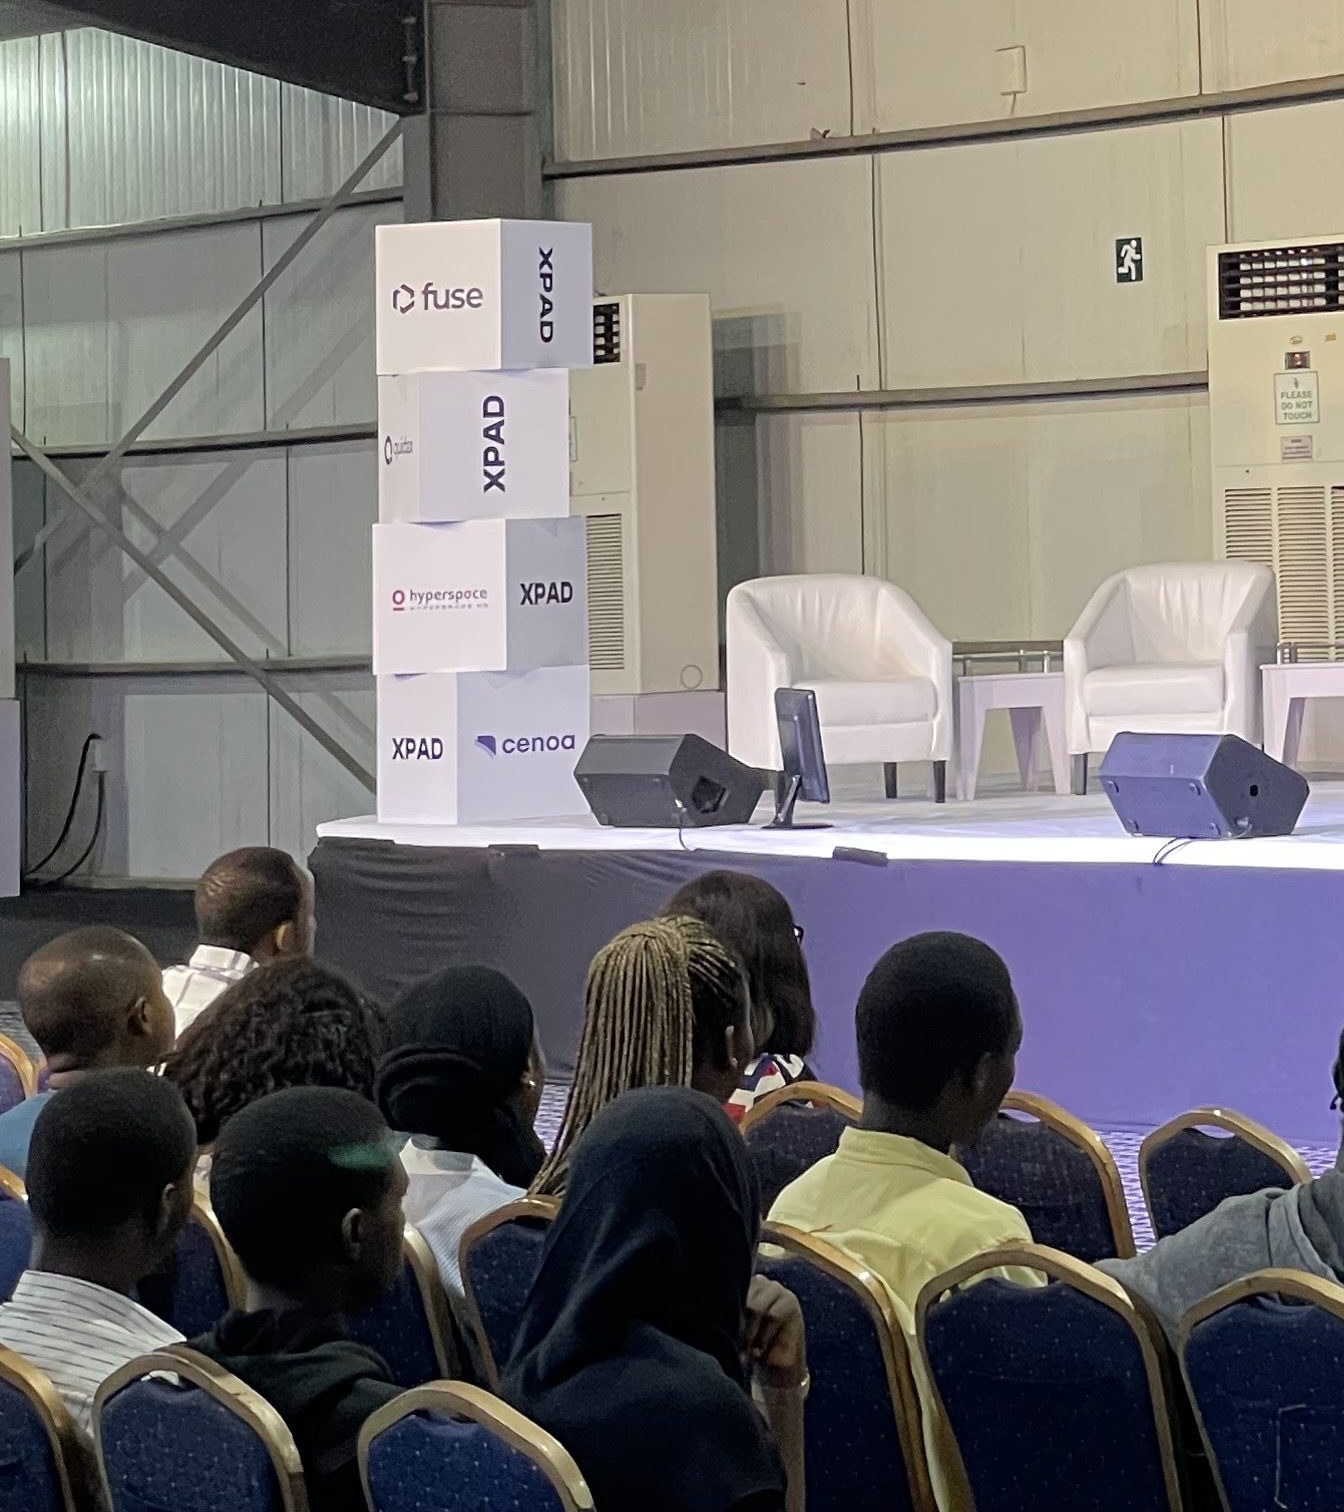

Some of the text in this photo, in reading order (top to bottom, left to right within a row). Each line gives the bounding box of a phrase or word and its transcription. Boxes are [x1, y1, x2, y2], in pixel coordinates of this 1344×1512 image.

[421, 282, 484, 311] fuse
[538, 246, 554, 343] XPAD
[1280, 390, 1313, 400] PLEASE
[482, 394, 506, 494] XPAD
[409, 588, 488, 605] hyperspace
[519, 581, 574, 606] XPAD
[391, 737, 444, 761] XPAD
[502, 734, 576, 755] cenoa
